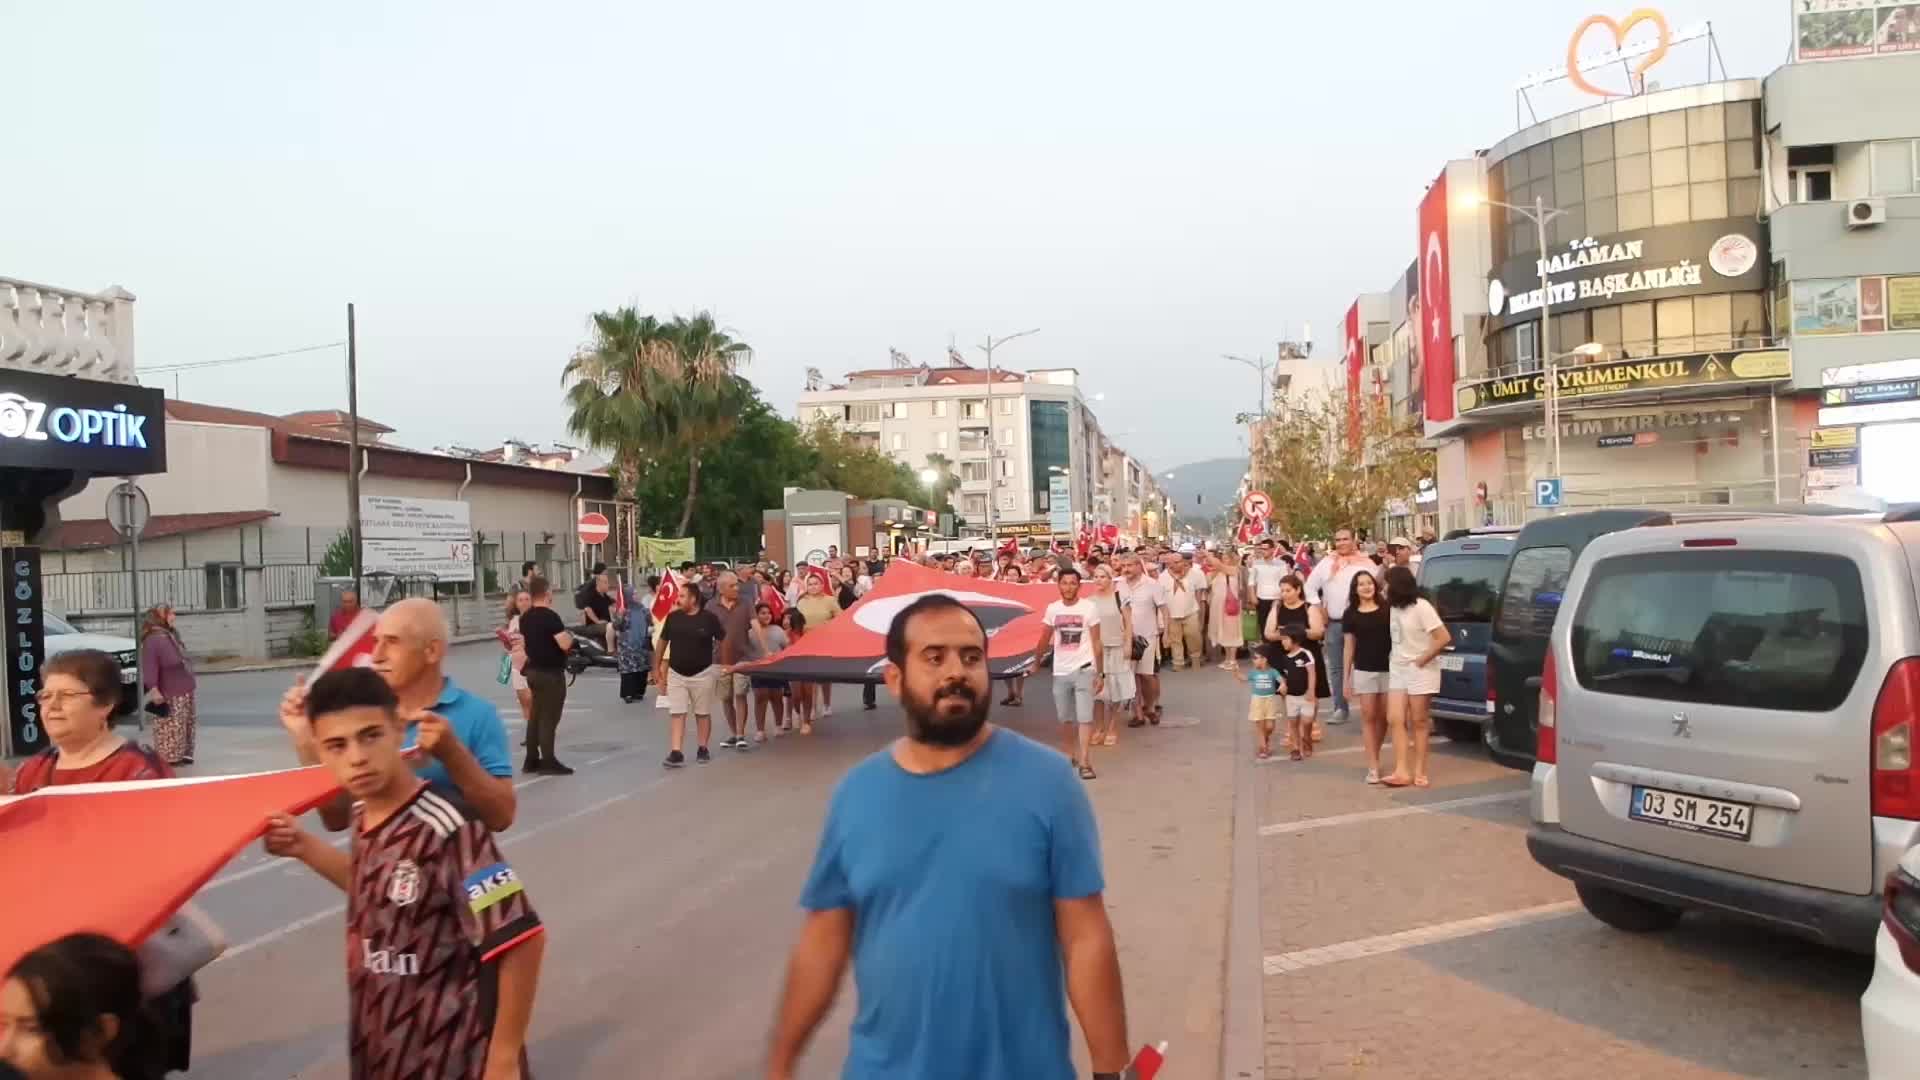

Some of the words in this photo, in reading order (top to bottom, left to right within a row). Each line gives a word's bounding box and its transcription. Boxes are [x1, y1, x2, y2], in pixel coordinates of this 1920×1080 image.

[1535, 240, 1643, 277] DALAMAN
[1578, 260, 1702, 299] BAŞKANLIĞI
[1533, 361, 1690, 391] GYRİMENKUL
[49, 404, 147, 449] OPTİK
[1537, 482, 1553, 504] P
[1643, 792, 1666, 814] 03
[1672, 797, 1698, 822] SM
[1706, 803, 1745, 831] 254
